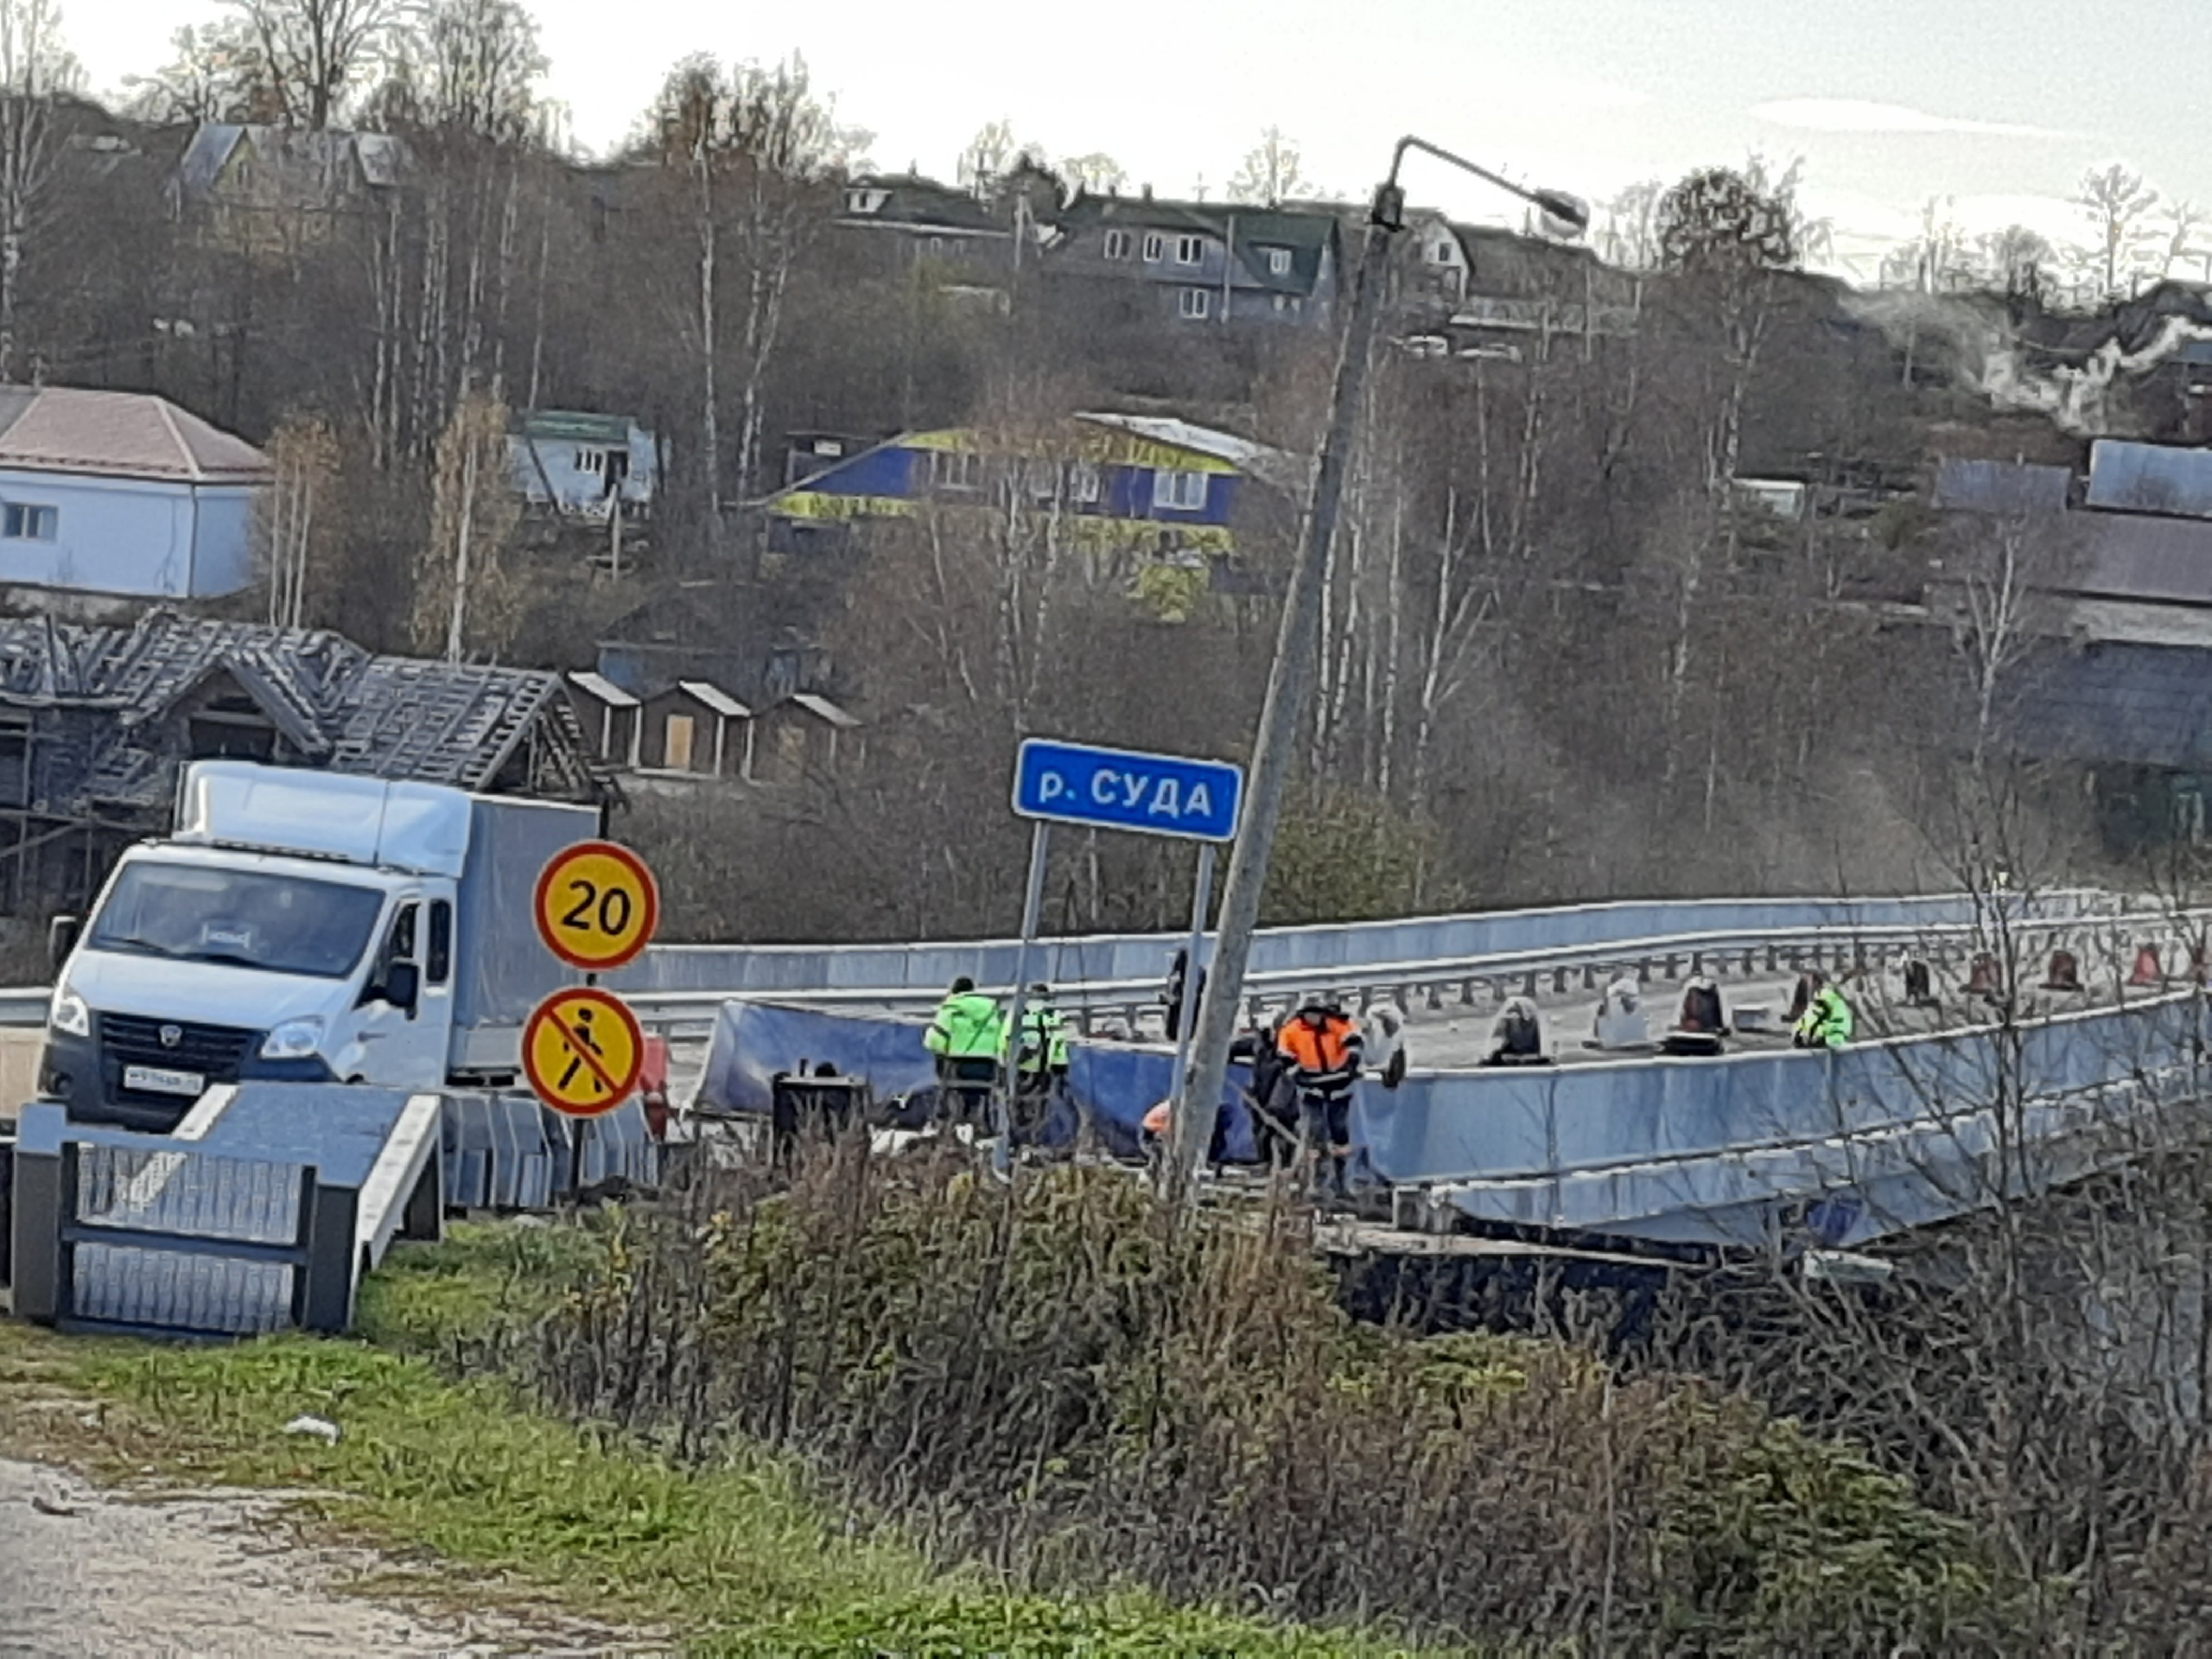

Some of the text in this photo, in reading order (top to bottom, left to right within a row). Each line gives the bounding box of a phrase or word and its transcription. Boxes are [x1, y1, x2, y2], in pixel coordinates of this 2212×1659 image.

[1039, 769, 1211, 819] р. СУДА
[561, 879, 632, 936] 20
